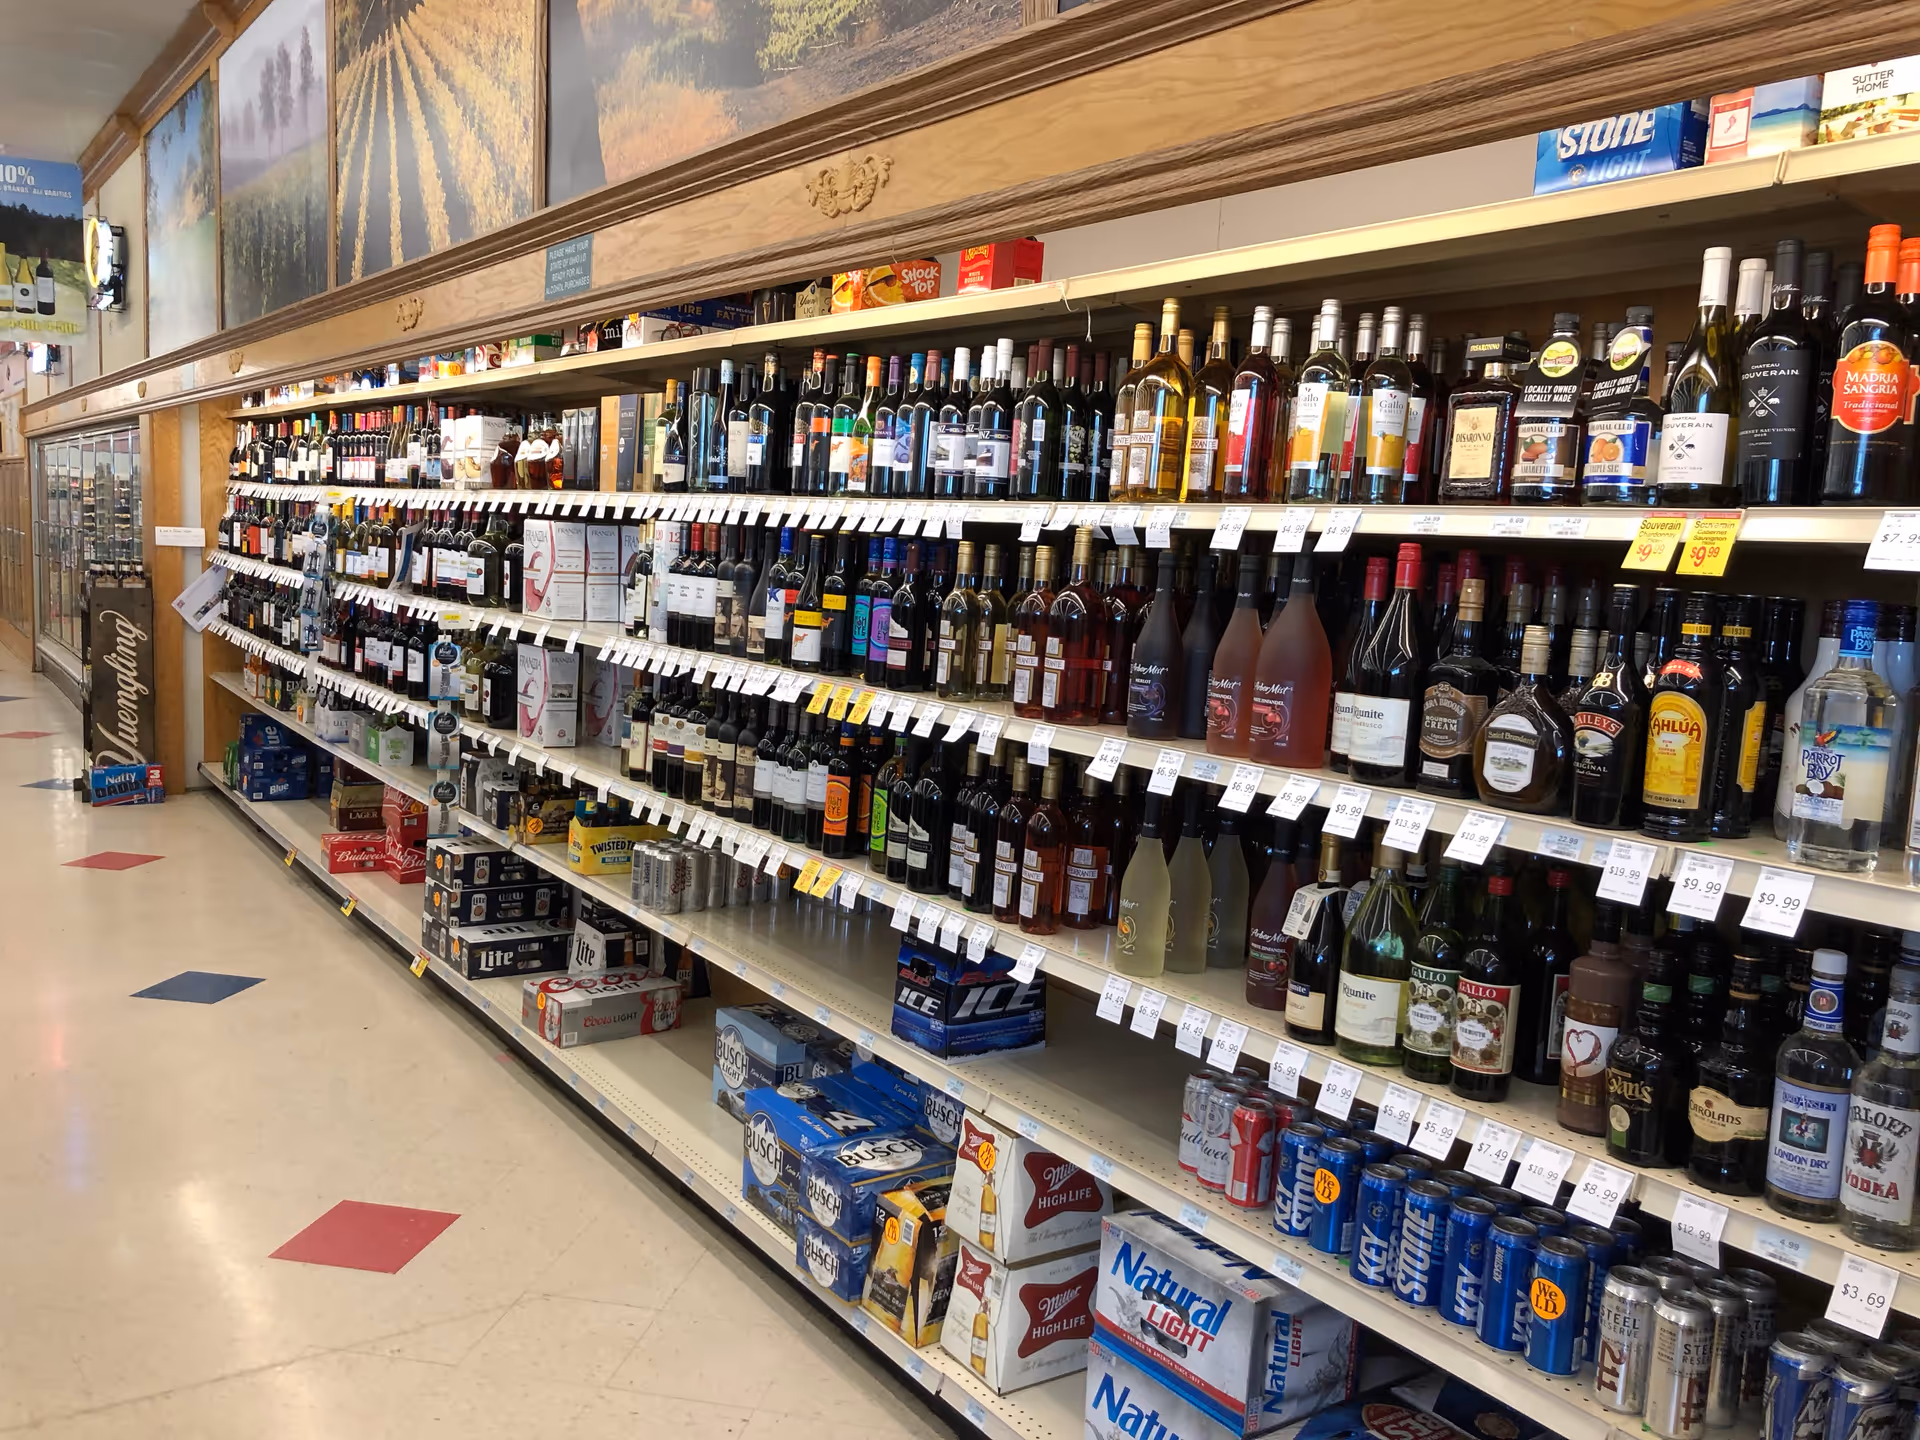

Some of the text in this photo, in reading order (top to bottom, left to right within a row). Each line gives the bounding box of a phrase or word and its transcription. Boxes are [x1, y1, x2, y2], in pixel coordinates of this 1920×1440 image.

[1852, 69, 1895, 86] SUTTER
[1856, 80, 1889, 94] HOME
[1586, 150, 1651, 183] LIGHT
[901, 266, 940, 284] SHOCK
[910, 280, 936, 294] TOP
[1741, 369, 1799, 380] SOUVERAIN
[1751, 362, 1780, 370] CHATEAU
[1594, 374, 1638, 391] LOCALLY OWNED
[1845, 371, 1899, 384] MADRIA
[1523, 393, 1572, 402] LOCALLY MADE
[1524, 385, 1577, 394] LOCALLY OWNED
[1591, 384, 1632, 400] LOCALLY MADE
[1843, 383, 1898, 395] SANGRIA
[1379, 399, 1404, 411] Gallo
[1843, 400, 1898, 410] Tradicional
[1613, 423, 1632, 431] CLUB
[1455, 432, 1492, 443] DISARONNO
[557, 527, 583, 536] FRANZIA
[591, 529, 616, 537] FRANZIA
[1149, 521, 1170, 531] $4.99
[1219, 523, 1243, 533] $4.99
[1281, 521, 1305, 533] $4.99
[1326, 525, 1351, 536] $4.99
[1640, 519, 1682, 530] Souverain
[1694, 521, 1736, 529] Souverain
[95, 609, 148, 765] Yuengling
[1438, 683, 1450, 692] 25
[1424, 720, 1457, 732] CREAM
[1425, 716, 1457, 724] BOURBON
[1574, 712, 1620, 733] BAILEYS
[1650, 711, 1701, 743] KAHLÚA
[1099, 754, 1119, 765] $4.49
[1573, 761, 1608, 773] ORIGINAL
[1801, 750, 1846, 772] PARROT
[105, 771, 137, 785] Natty
[149, 769, 161, 780] 3
[1156, 767, 1178, 778] $6.99
[1806, 763, 1835, 781] BAY
[269, 783, 289, 795] Blue
[1231, 781, 1255, 794] $6.99
[1280, 792, 1307, 805] $5.99
[1655, 796, 1686, 804] ORIGINAL
[349, 811, 378, 819] LAGER
[1335, 803, 1362, 817] $9.99
[1394, 818, 1421, 831] $13.99
[1460, 831, 1489, 844] $10.99
[1557, 835, 1578, 845] 22.99
[590, 840, 627, 855] TWISTED
[1608, 866, 1641, 880] $19.99
[1682, 877, 1722, 895] $9.99
[1758, 891, 1801, 911] $9.99
[1269, 932, 1290, 944] Mist
[478, 950, 514, 971] Lite
[575, 939, 597, 966] Lite
[900, 967, 930, 987] Bud
[1411, 966, 1447, 983] GALLO
[585, 981, 642, 995] LIGHT
[1342, 982, 1377, 1001] Riunite
[1459, 981, 1497, 998] GALLO
[898, 986, 941, 1016] ICE
[952, 982, 1041, 1019] ICE
[1104, 992, 1124, 1006] $4.49
[584, 1011, 638, 1028] Coors LIGHT
[653, 1010, 677, 1022] LIGHT
[1138, 1005, 1160, 1019] $6.99
[1182, 1021, 1203, 1037] $4.49
[1215, 1039, 1239, 1054] $6.99
[716, 1036, 749, 1079] BUSCH
[722, 1062, 741, 1082] LIGHT
[1273, 1061, 1298, 1077] $5.99
[1325, 1083, 1352, 1100] $9.99
[925, 1095, 962, 1133] BUSCH
[1382, 1104, 1411, 1123] $5.99
[1688, 1099, 1742, 1126] CAROLANS
[1423, 1121, 1454, 1139] $5.99
[745, 1122, 783, 1174] BUSCH
[836, 1137, 927, 1168] BUSCH
[1477, 1142, 1509, 1162] $7.49
[1774, 1146, 1831, 1170] LONDON DRY
[1318, 1172, 1335, 1188] We
[1527, 1163, 1560, 1182] $10.99
[855, 1186, 865, 1195] 12
[1844, 1166, 1900, 1200] VODKA
[806, 1175, 842, 1220] BUSCH
[1037, 1187, 1092, 1210] HIGH LIFE
[1582, 1181, 1619, 1203] $8.99
[1275, 1175, 1292, 1232] KEY
[875, 1206, 886, 1222] 12
[933, 1225, 947, 1238] 12
[1431, 1214, 1446, 1266] LIGHT
[1677, 1222, 1711, 1242] $12.99
[1396, 1197, 1436, 1303] STONE
[1779, 1238, 1800, 1251] 4.99
[803, 1234, 839, 1281] BUSCH
[1357, 1224, 1390, 1284] KEY
[1492, 1245, 1506, 1284] KEYSTONE
[961, 1272, 984, 1294] HIGH LIFE
[1111, 1241, 1233, 1337] Natural
[1537, 1278, 1558, 1300] We
[1454, 1262, 1484, 1322] KEY
[1841, 1283, 1886, 1309] $3.69
[1038, 1285, 1083, 1323] Miller
[1032, 1315, 1087, 1339] HIGH LIFE
[1600, 1308, 1639, 1329] STEEL
[1147, 1302, 1215, 1353] LIGHT
[1290, 1315, 1305, 1368] LIGHT
[1153, 1351, 1173, 1366] AMERICA
[1264, 1310, 1291, 1414] Natural
[1597, 1341, 1625, 1393] 211
